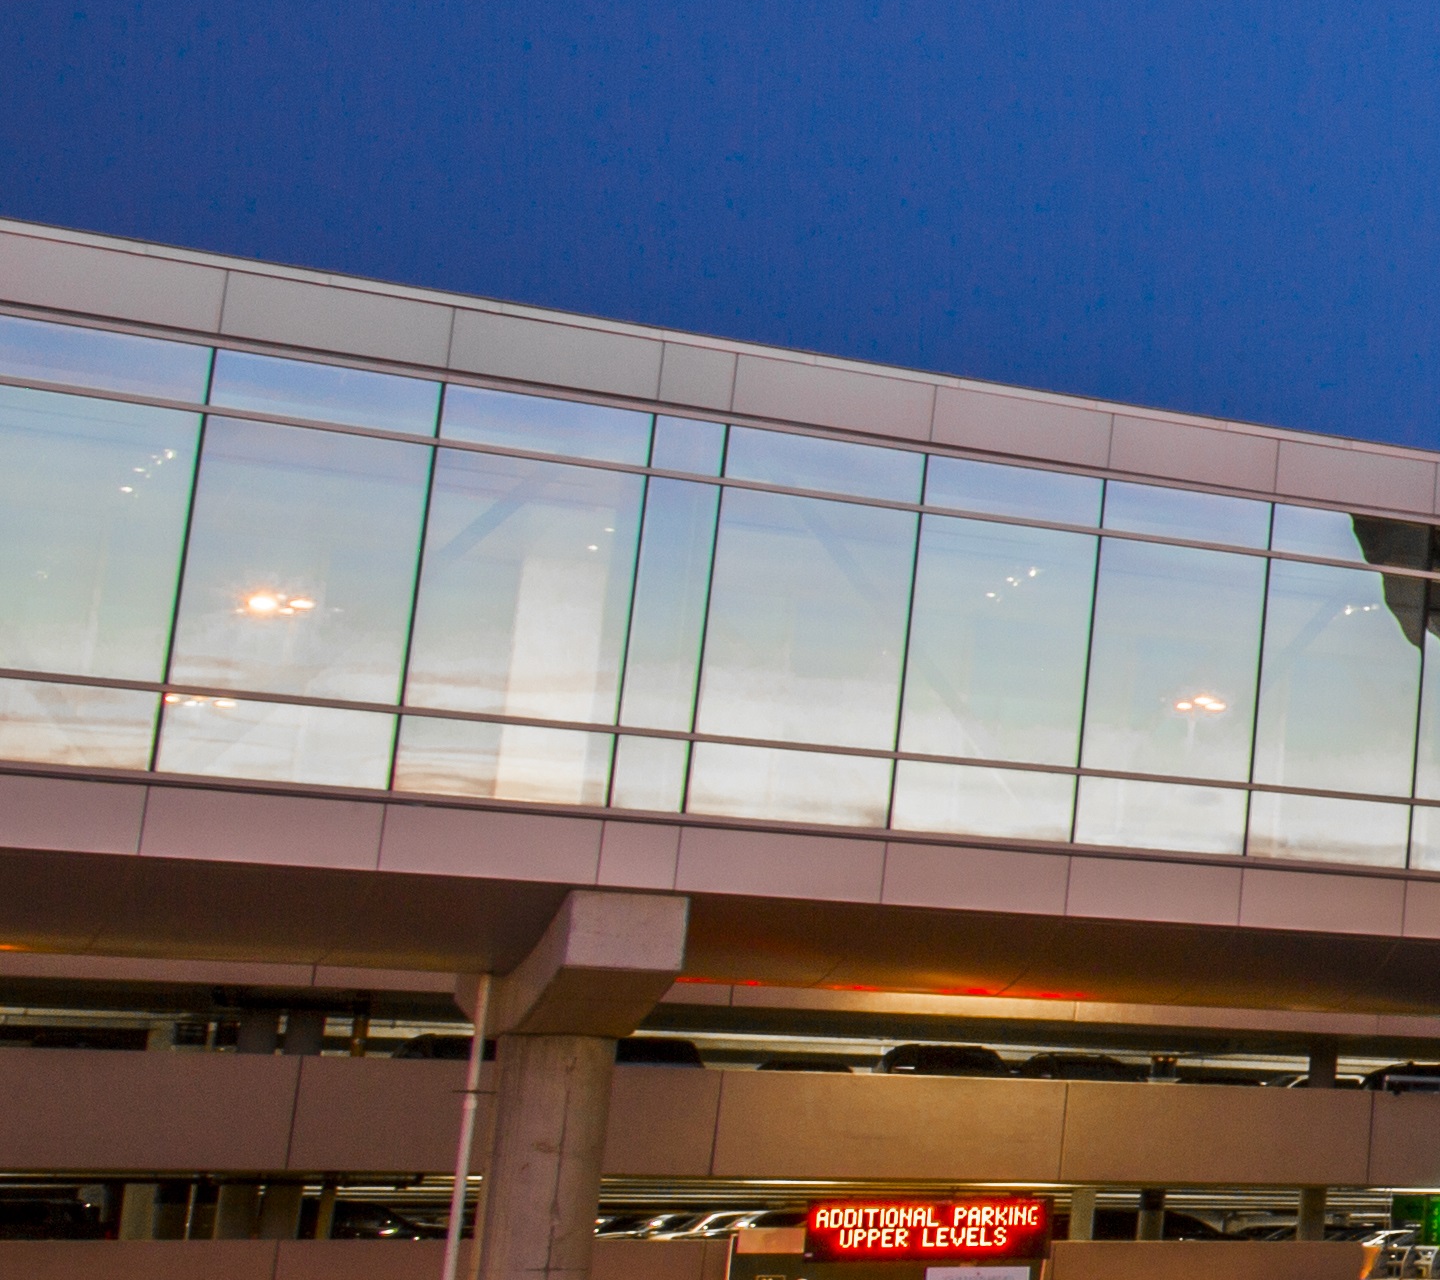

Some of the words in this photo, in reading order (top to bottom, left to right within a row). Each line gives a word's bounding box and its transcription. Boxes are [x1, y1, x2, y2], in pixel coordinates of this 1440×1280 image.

[816, 1208, 940, 1229] ADDITIONAL
[953, 1206, 1039, 1226] PARKING
[839, 1228, 909, 1248] UPPER
[922, 1226, 1008, 1247] LEVELS
